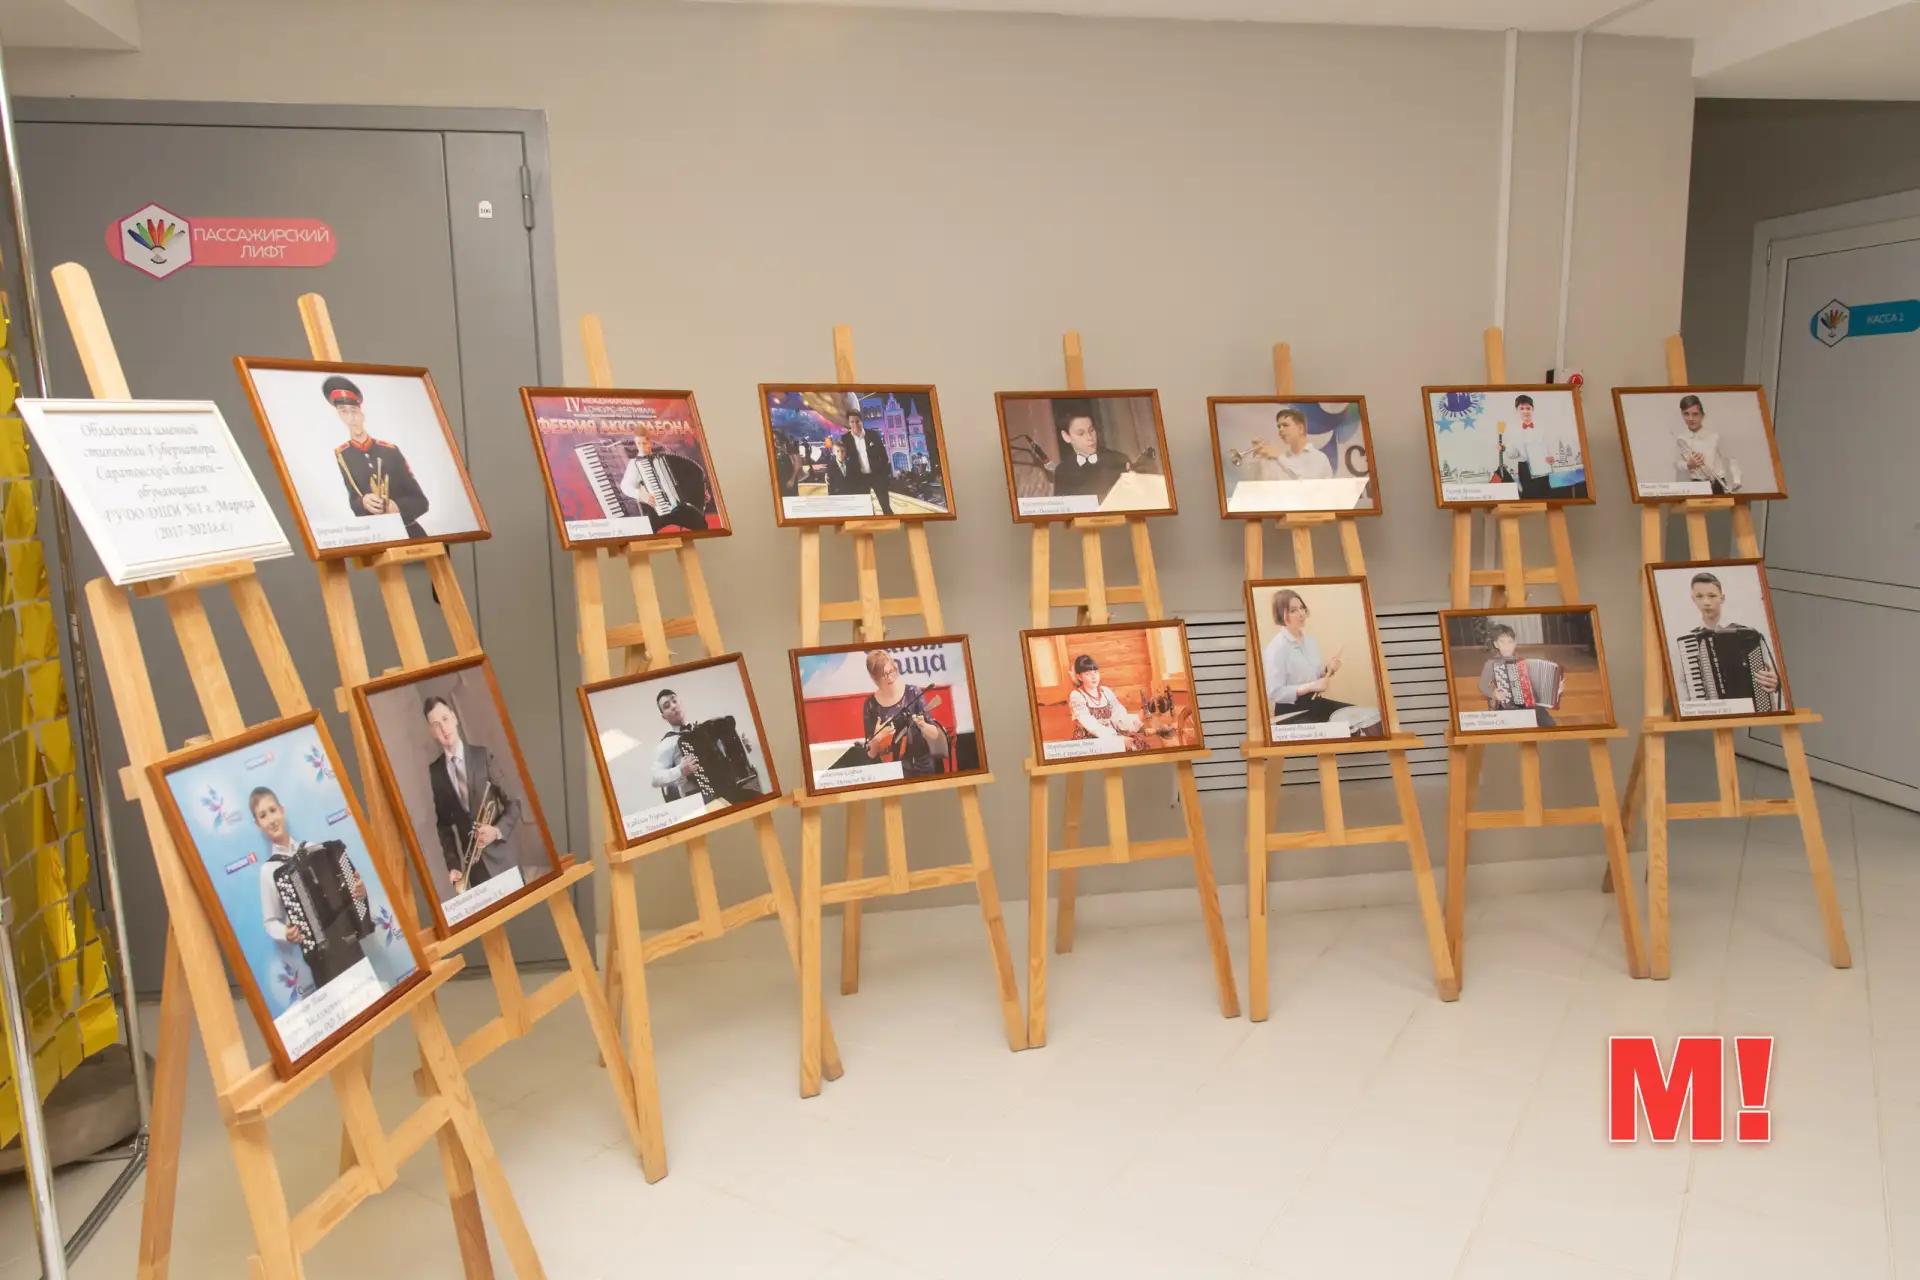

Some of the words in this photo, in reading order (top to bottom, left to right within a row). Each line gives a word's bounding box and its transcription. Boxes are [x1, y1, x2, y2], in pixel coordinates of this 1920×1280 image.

[193, 227, 329, 242] ПАССАЖИРСКИЙ
[240, 246, 288, 258] ЛИФТ
[1867, 314, 1898, 324] КАССА
[564, 397, 580, 412] IV
[81, 422, 152, 437] Обладатели
[154, 424, 198, 436] именной
[537, 417, 597, 435] ФЕЕРИЯ
[84, 445, 145, 458] стипендии
[148, 441, 217, 461] Губернатора
[96, 464, 170, 483] Саратовской
[172, 461, 215, 475] области
[137, 483, 209, 502] обучающиеся
[894, 653, 947, 678] ица
